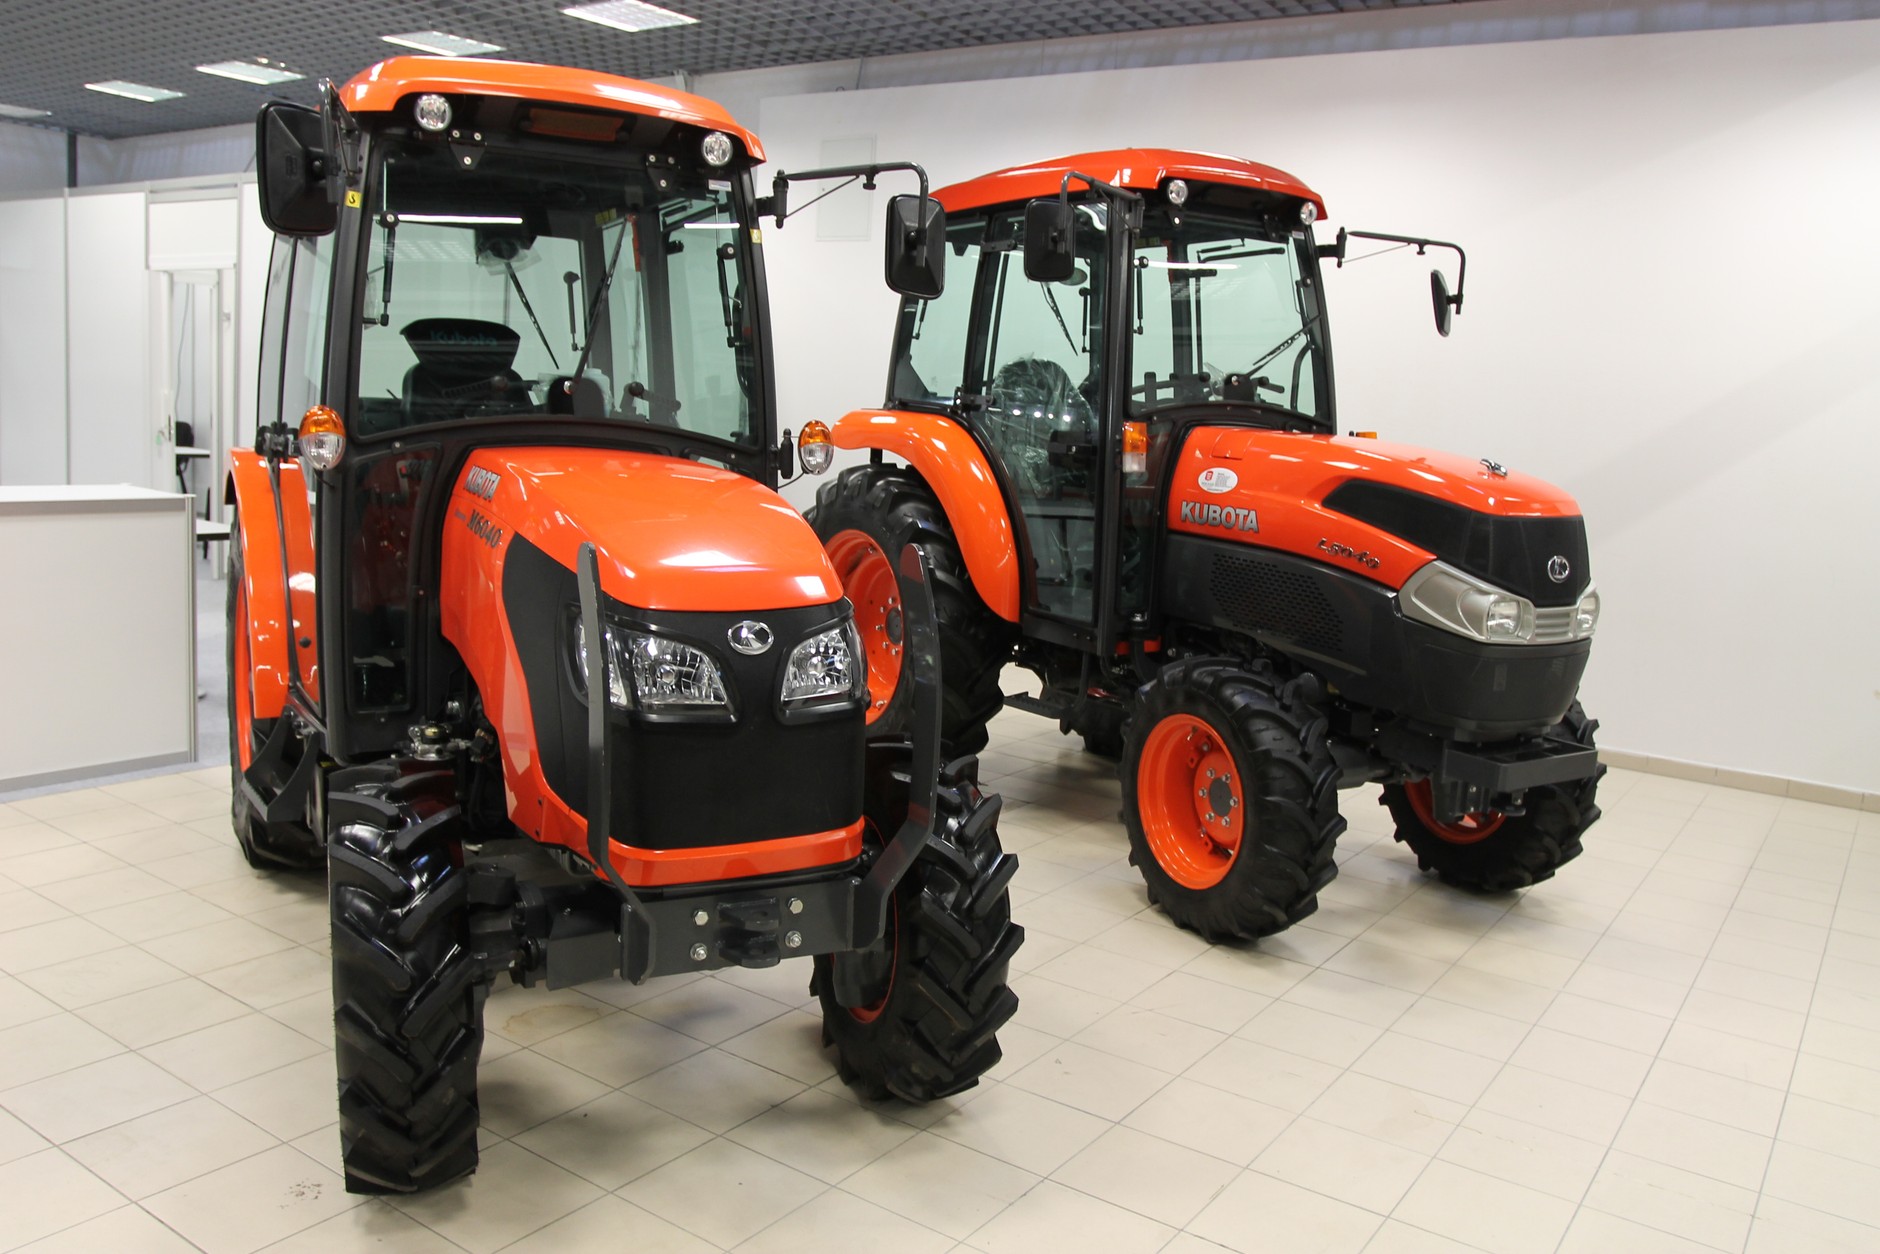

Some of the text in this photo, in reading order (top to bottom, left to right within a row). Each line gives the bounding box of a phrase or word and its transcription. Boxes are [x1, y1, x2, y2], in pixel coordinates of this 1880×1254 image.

[430, 329, 498, 346] Kubota
[464, 465, 501, 501] KUBOTA
[467, 509, 503, 548] M6040
[1181, 500, 1259, 533] KUBOTA
[1317, 537, 1380, 568] L5040
